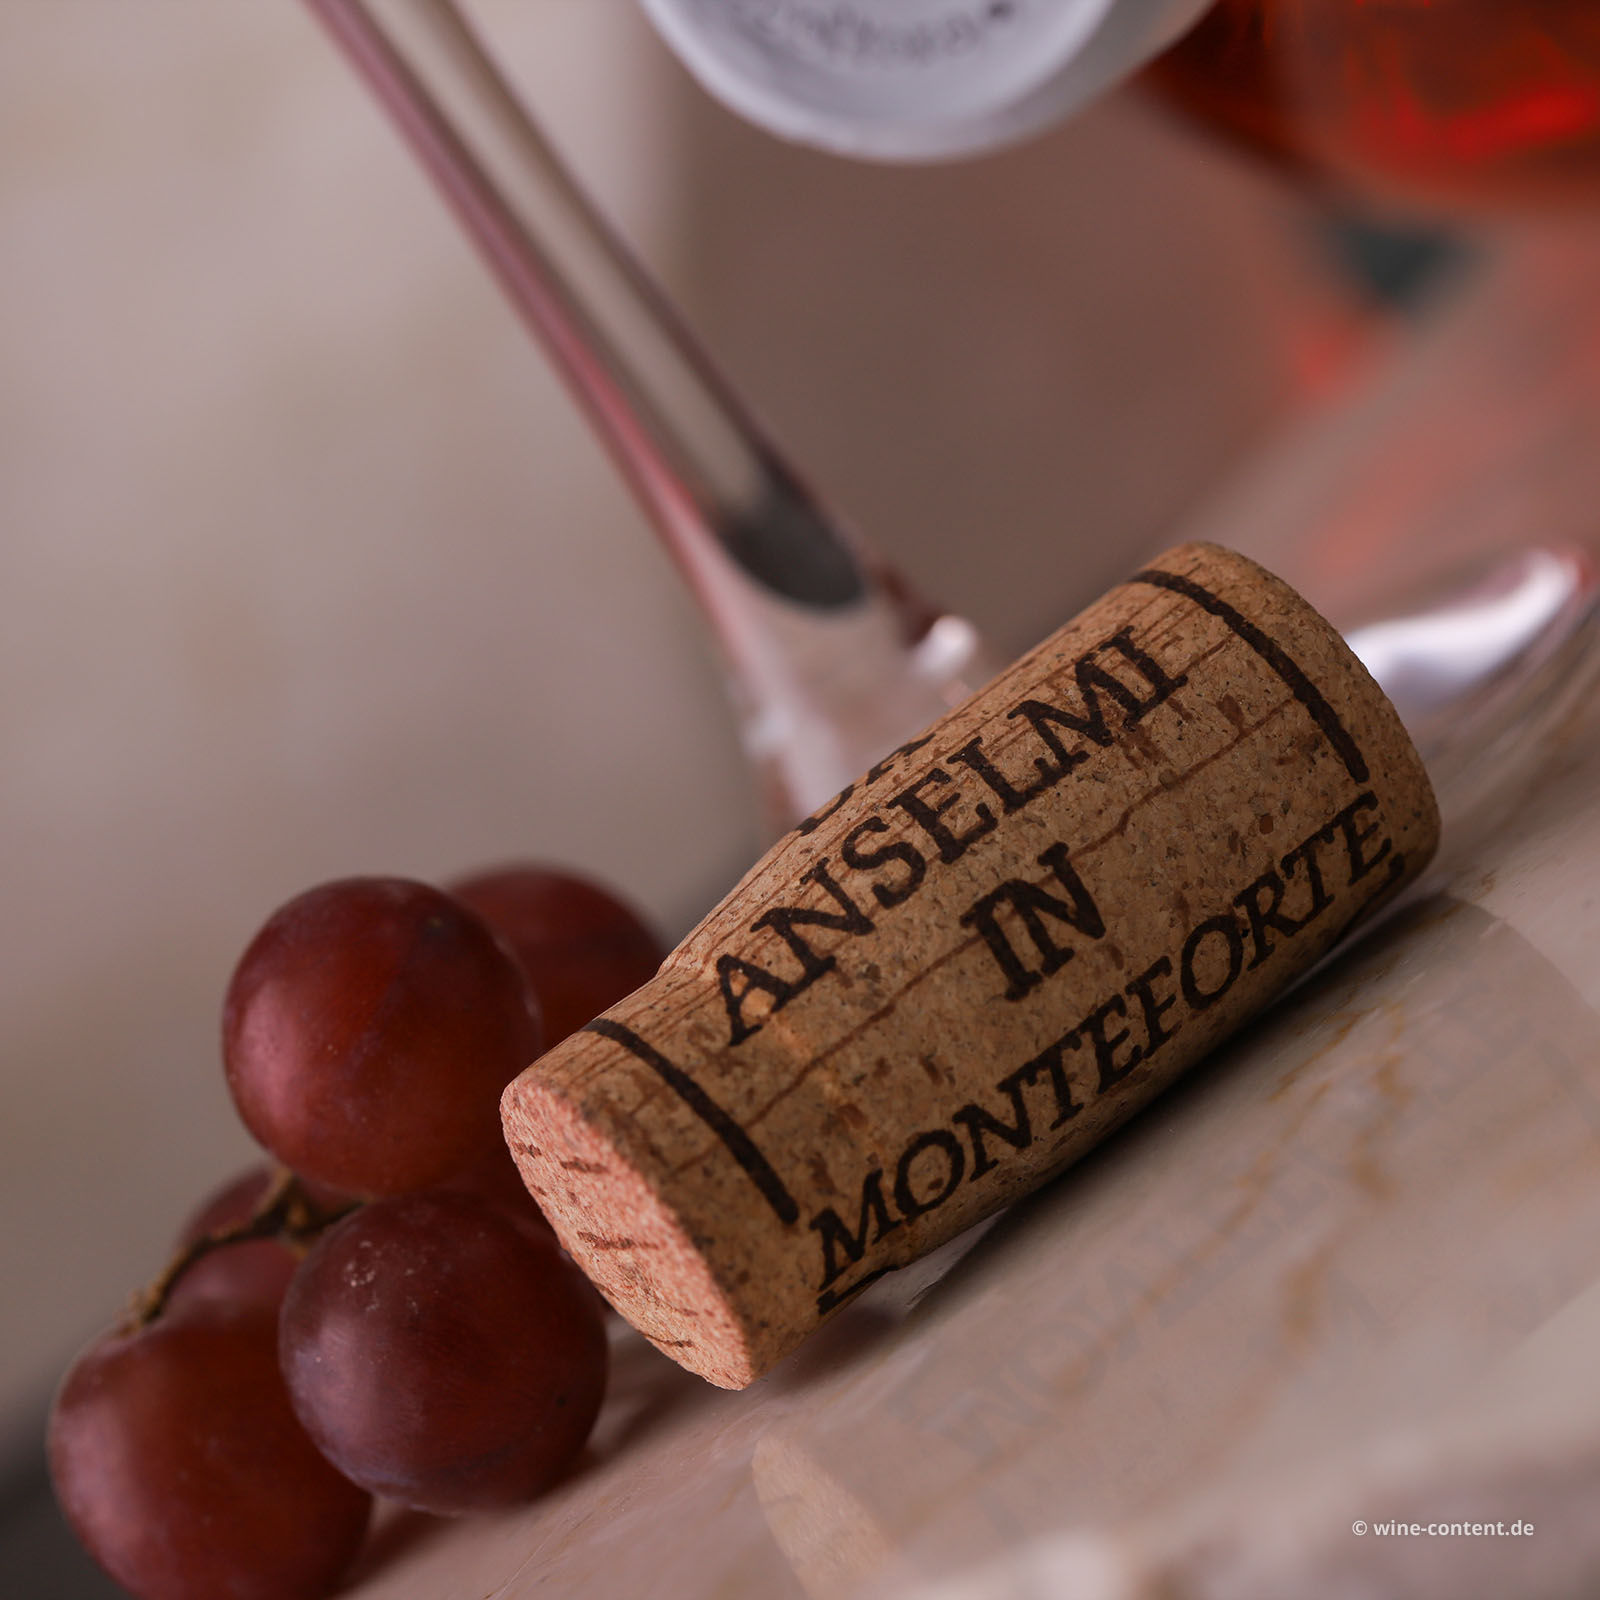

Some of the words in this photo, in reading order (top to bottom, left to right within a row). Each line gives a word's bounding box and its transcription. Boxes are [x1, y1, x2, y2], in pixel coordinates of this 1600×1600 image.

[714, 625, 1187, 1046] ANSELMI
[808, 790, 1393, 1292] MONTEFORTE
[960, 842, 1106, 1002] IN
